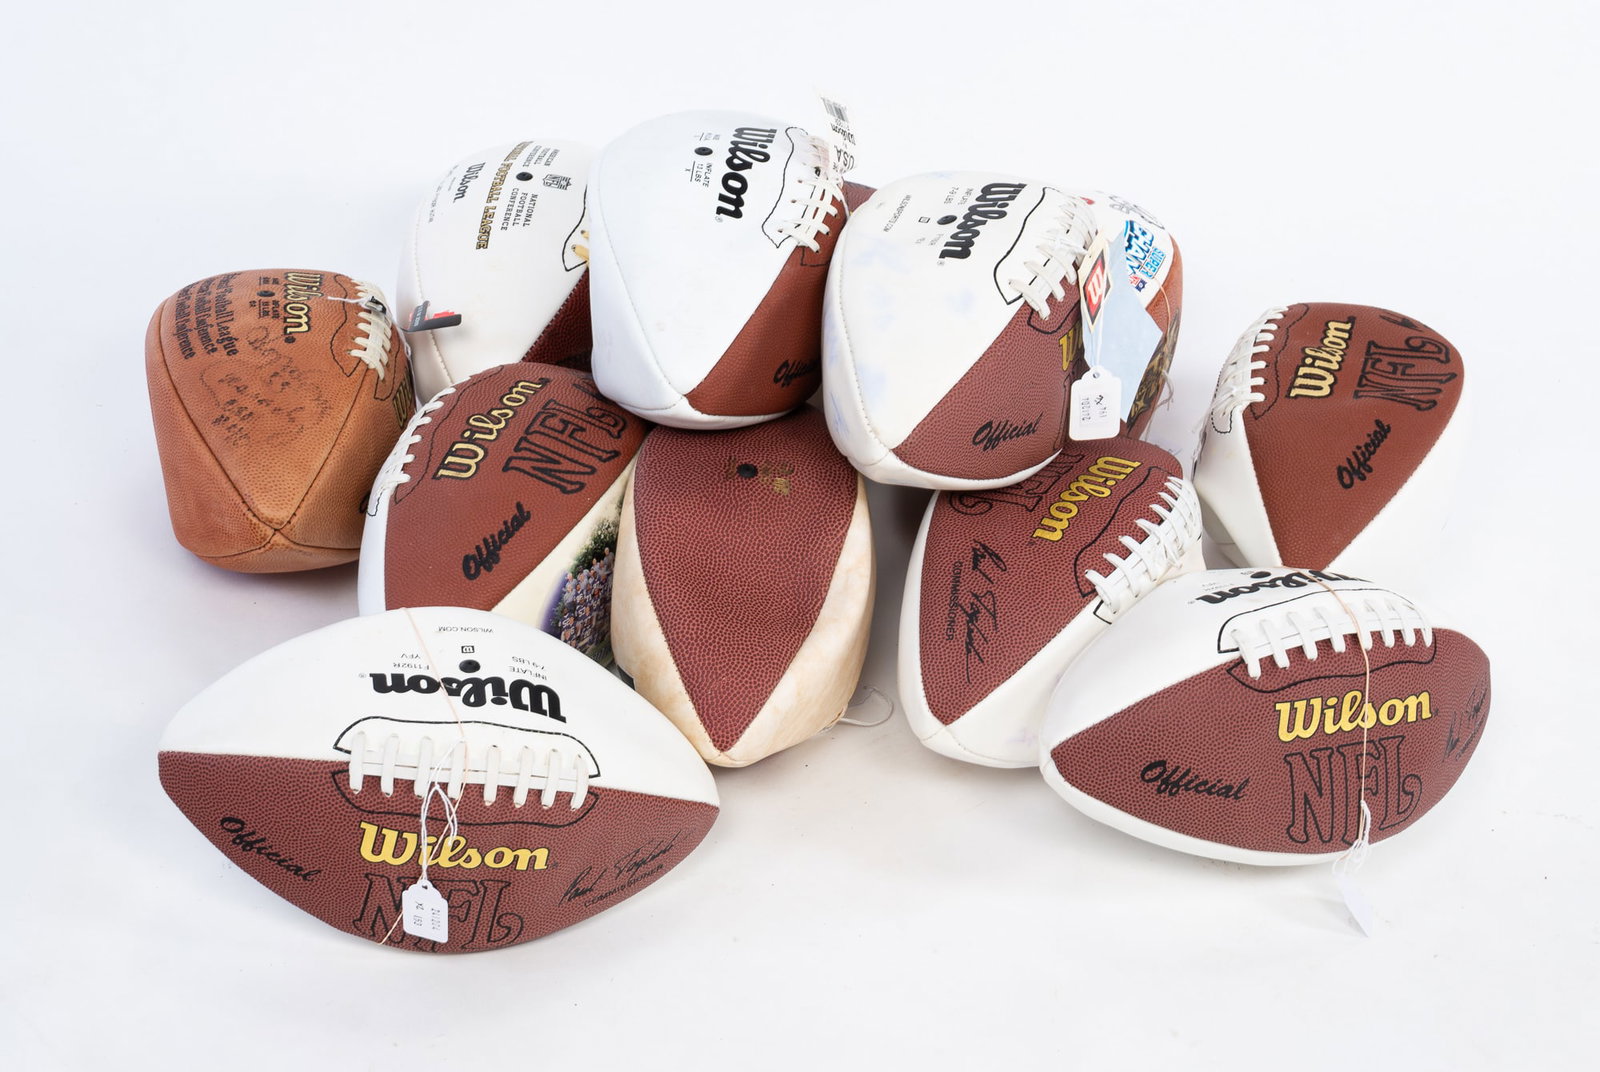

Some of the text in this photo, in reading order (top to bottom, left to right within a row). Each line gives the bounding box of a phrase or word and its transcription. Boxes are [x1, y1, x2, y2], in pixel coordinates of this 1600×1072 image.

[453, 162, 486, 204] Wilson
[486, 162, 513, 204] FOOTBALL
[716, 127, 777, 219] Wilson
[475, 205, 497, 250] LEAGUE
[500, 187, 519, 231] CONFERENCE
[512, 192, 528, 227] FOOTBALL
[523, 193, 538, 227] NATIONAL
[938, 182, 1028, 260] Wilson
[1140, 247, 1166, 278] SUPER
[284, 272, 324, 335] Wilson
[216, 317, 239, 356] League
[1285, 317, 1356, 399] Wilson
[1353, 335, 1458, 411] NFL
[432, 378, 547, 480] Wilson
[502, 399, 629, 495] NFL
[972, 412, 1044, 451] Official
[1336, 418, 1391, 489] Official
[1032, 456, 1143, 542] Wilson
[462, 501, 532, 581] Official
[946, 561, 962, 641] COMMISSIONER
[1195, 569, 1374, 605] Wilson
[369, 673, 567, 724] Wilson
[508, 665, 548, 681] INFLATE
[1275, 690, 1432, 743] Wilson
[1140, 760, 1250, 801] Official
[1284, 735, 1423, 846] NFL
[219, 816, 321, 883] Official
[359, 821, 550, 871] Wilson
